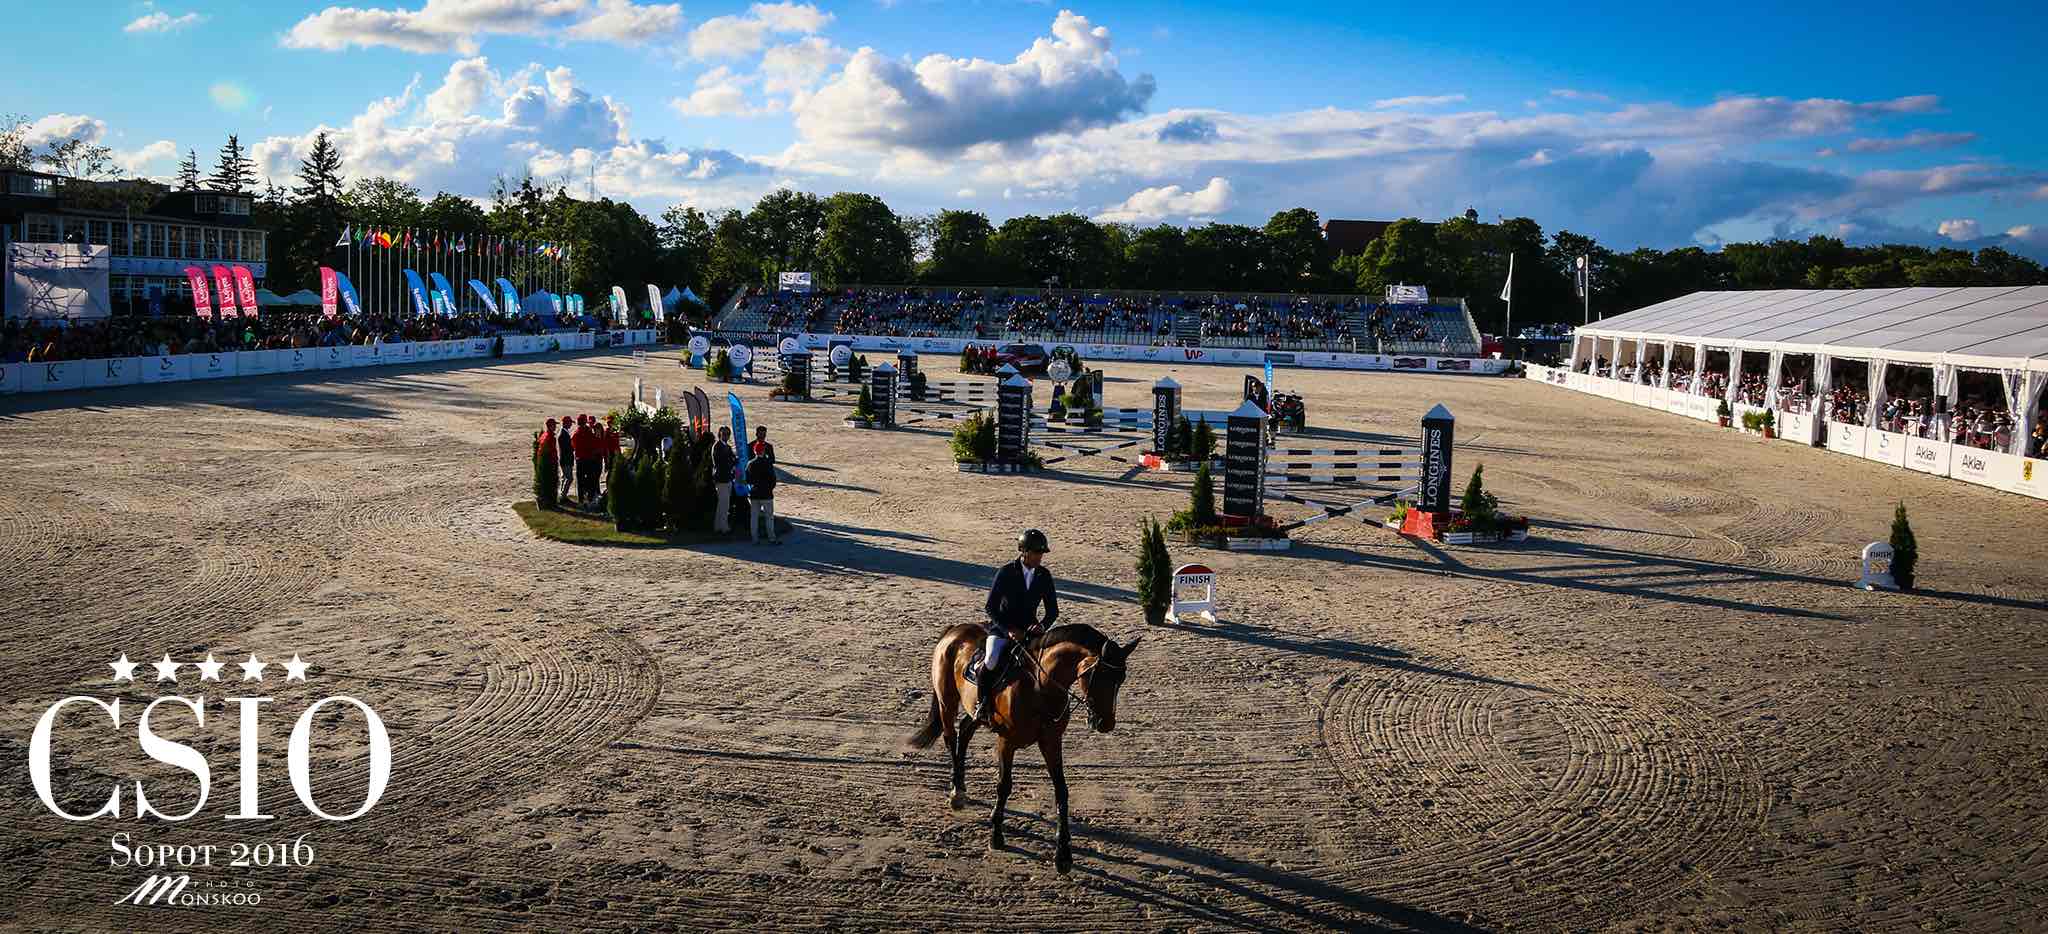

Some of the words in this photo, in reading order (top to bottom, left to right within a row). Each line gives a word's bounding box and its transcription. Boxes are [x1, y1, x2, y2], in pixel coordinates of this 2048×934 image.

[1157, 394, 1168, 452] LONGINES
[1427, 429, 1441, 507] LONGINES
[1180, 575, 1210, 585] FINISH
